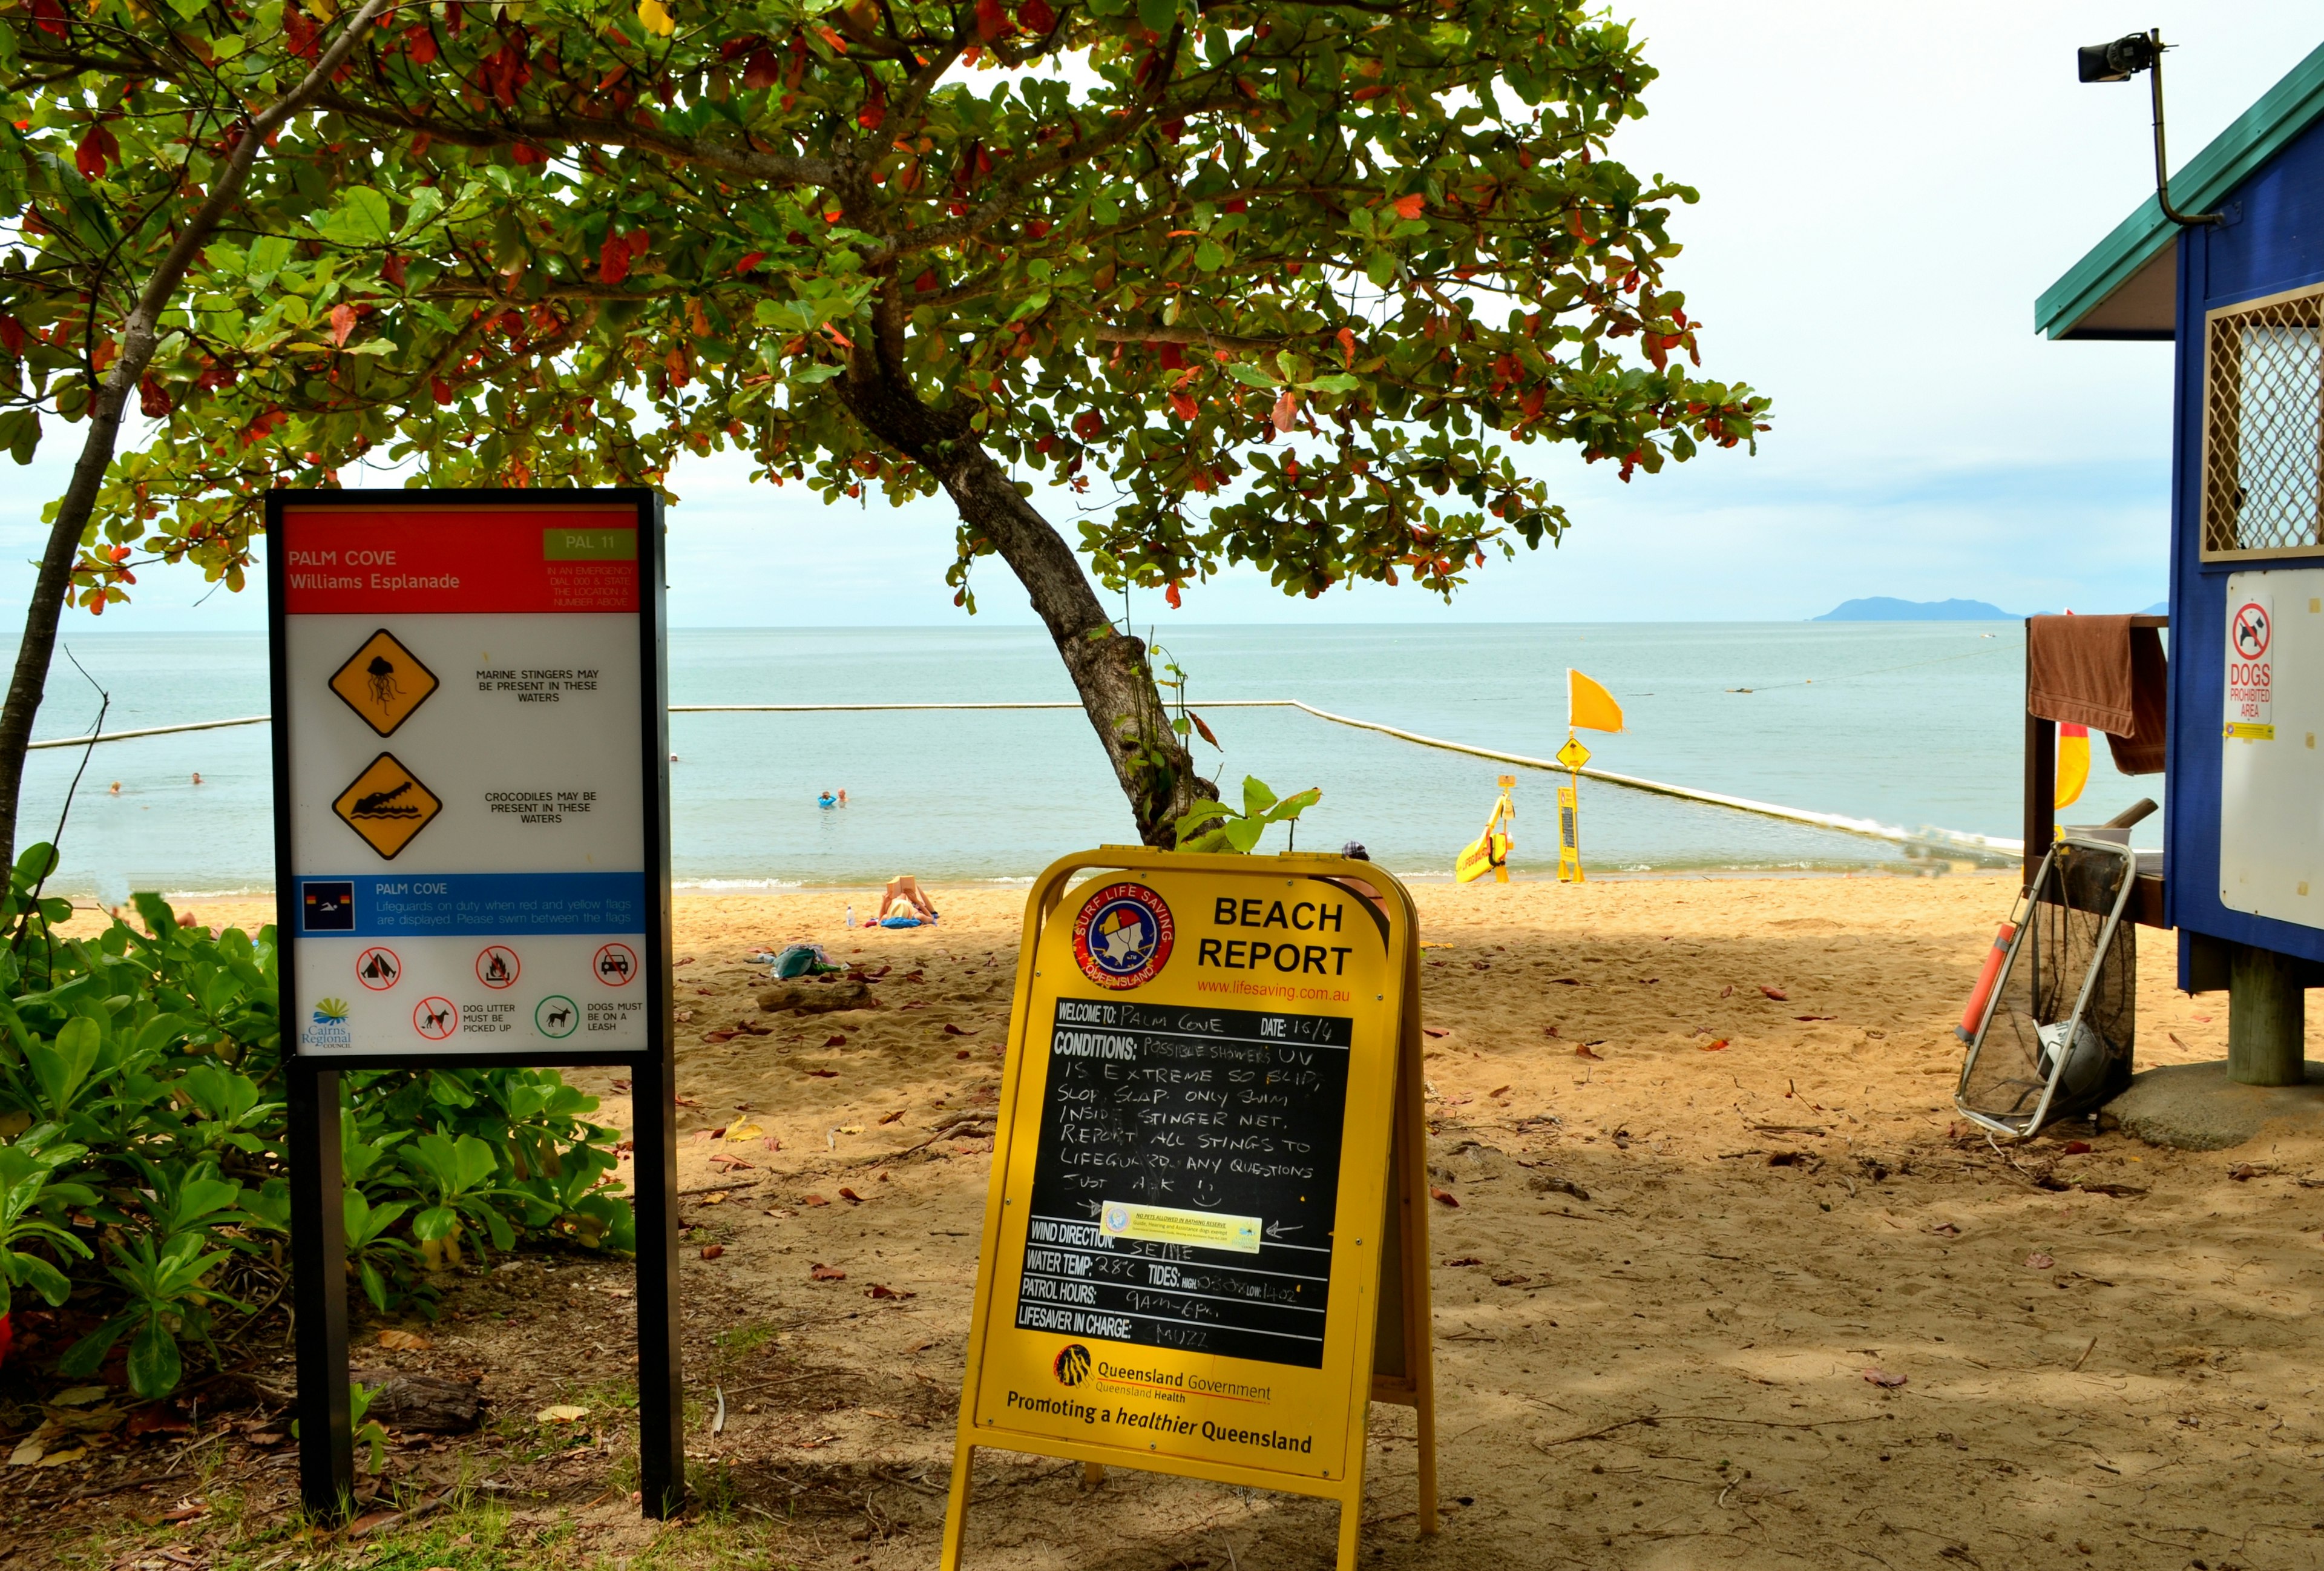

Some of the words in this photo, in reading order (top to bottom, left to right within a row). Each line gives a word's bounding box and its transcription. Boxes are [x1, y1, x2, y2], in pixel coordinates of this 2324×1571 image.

[566, 536, 594, 548] PAL
[601, 536, 614, 548] 11
[289, 551, 336, 565] PALM
[345, 550, 396, 565] COVE
[576, 567, 633, 575] EMERGENCY
[290, 574, 363, 588] Williams
[370, 573, 460, 591] Esplanade
[550, 577, 570, 585] DIAL
[573, 577, 590, 585] 000
[605, 577, 631, 585] STATE
[554, 587, 571, 596] THE
[575, 587, 619, 596] LOCATION
[597, 598, 628, 606] ABOVE
[476, 670, 516, 679] MARINE
[521, 670, 573, 679] STINGERS
[577, 670, 599, 679] MAY
[2231, 664, 2270, 687] DOGS
[479, 682, 493, 691] BE
[497, 682, 544, 691] PRESENT
[549, 682, 559, 690] IN
[564, 681, 597, 690] THESE
[2230, 688, 2270, 702] PROHIBITED
[517, 693, 560, 702] WATERS
[2240, 703, 2259, 717] AREA
[485, 792, 553, 802] CROCODILES
[557, 792, 579, 801] MAY
[583, 792, 597, 800] BE
[491, 803, 538, 812] PRESENT
[542, 803, 553, 812] IN
[557, 803, 591, 812] THESE
[520, 814, 562, 823] WATERS
[376, 883, 408, 895] PALM
[413, 883, 447, 894] COVE
[376, 901, 433, 914] Lifeguards
[438, 902, 451, 911] on
[456, 900, 480, 912] duty
[485, 900, 514, 910] when
[519, 900, 537, 910] red
[542, 900, 563, 909] and
[567, 899, 600, 912] yellow
[606, 898, 632, 911] flags
[1075, 896, 1101, 937] SURF
[1105, 886, 1137, 901] LIFE
[1141, 891, 1173, 942] SAVING
[1214, 897, 1343, 932] BEACH
[377, 916, 394, 925] are
[457, 914, 493, 924] Please
[499, 914, 527, 924] swim
[531, 913, 579, 923] between
[583, 912, 600, 923] the
[606, 912, 632, 924] flags
[1198, 938, 1352, 975] REPORT
[1085, 964, 1154, 987] QUEENSLAND
[1198, 980, 1350, 1001] www.lifesaving.com.au
[1059, 1003, 1101, 1023] WELCOME
[1103, 1005, 1117, 1024] TO:
[308, 1026, 346, 1035] Cairns
[1261, 1018, 1287, 1037] DATE:
[1294, 1018, 1331, 1041] 16/4
[301, 1033, 351, 1047] Regional
[1054, 1031, 1137, 1061] CONDITIONS:
[1144, 1037, 1204, 1058] POSSIBLE
[1279, 1049, 1313, 1065] UV
[1065, 1061, 1089, 1078] IS
[1105, 1064, 1212, 1083] EXTREME
[1229, 1070, 1255, 1082] SO
[1185, 1090, 1228, 1108] ONLY
[1237, 1089, 1288, 1107] SWIM
[1138, 1109, 1228, 1126] STINGER
[1151, 1130, 1185, 1147] ALL
[1198, 1133, 1274, 1151] STINGS
[1282, 1139, 1311, 1153] TO
[1187, 1156, 1221, 1174] ANY
[1230, 1159, 1314, 1178] QUESTIONS
[1063, 1173, 1108, 1190] JUST
[1132, 1176, 1175, 1191] AK
[1031, 1220, 1058, 1242] WIND
[1028, 1249, 1062, 1273] WATER
[1063, 1253, 1094, 1277] TEMP:
[1148, 1263, 1181, 1288] TIDES:
[1022, 1277, 1059, 1300] PATROL
[1059, 1282, 1097, 1305] HOURS:
[1246, 1285, 1262, 1298] LOW:
[1019, 1305, 1073, 1329] LIFESAVER
[1074, 1312, 1085, 1332] IN
[1086, 1314, 1132, 1339] CHARGE:
[1098, 1362, 1183, 1386] Queensland
[1188, 1375, 1271, 1400] Government
[1096, 1381, 1152, 1398] Queensland
[1155, 1389, 1186, 1403] Health
[1007, 1391, 1097, 1424] Promoting
[1101, 1409, 1111, 1423] a
[1115, 1407, 1198, 1435] healthier
[1202, 1421, 1311, 1454] Queensland
